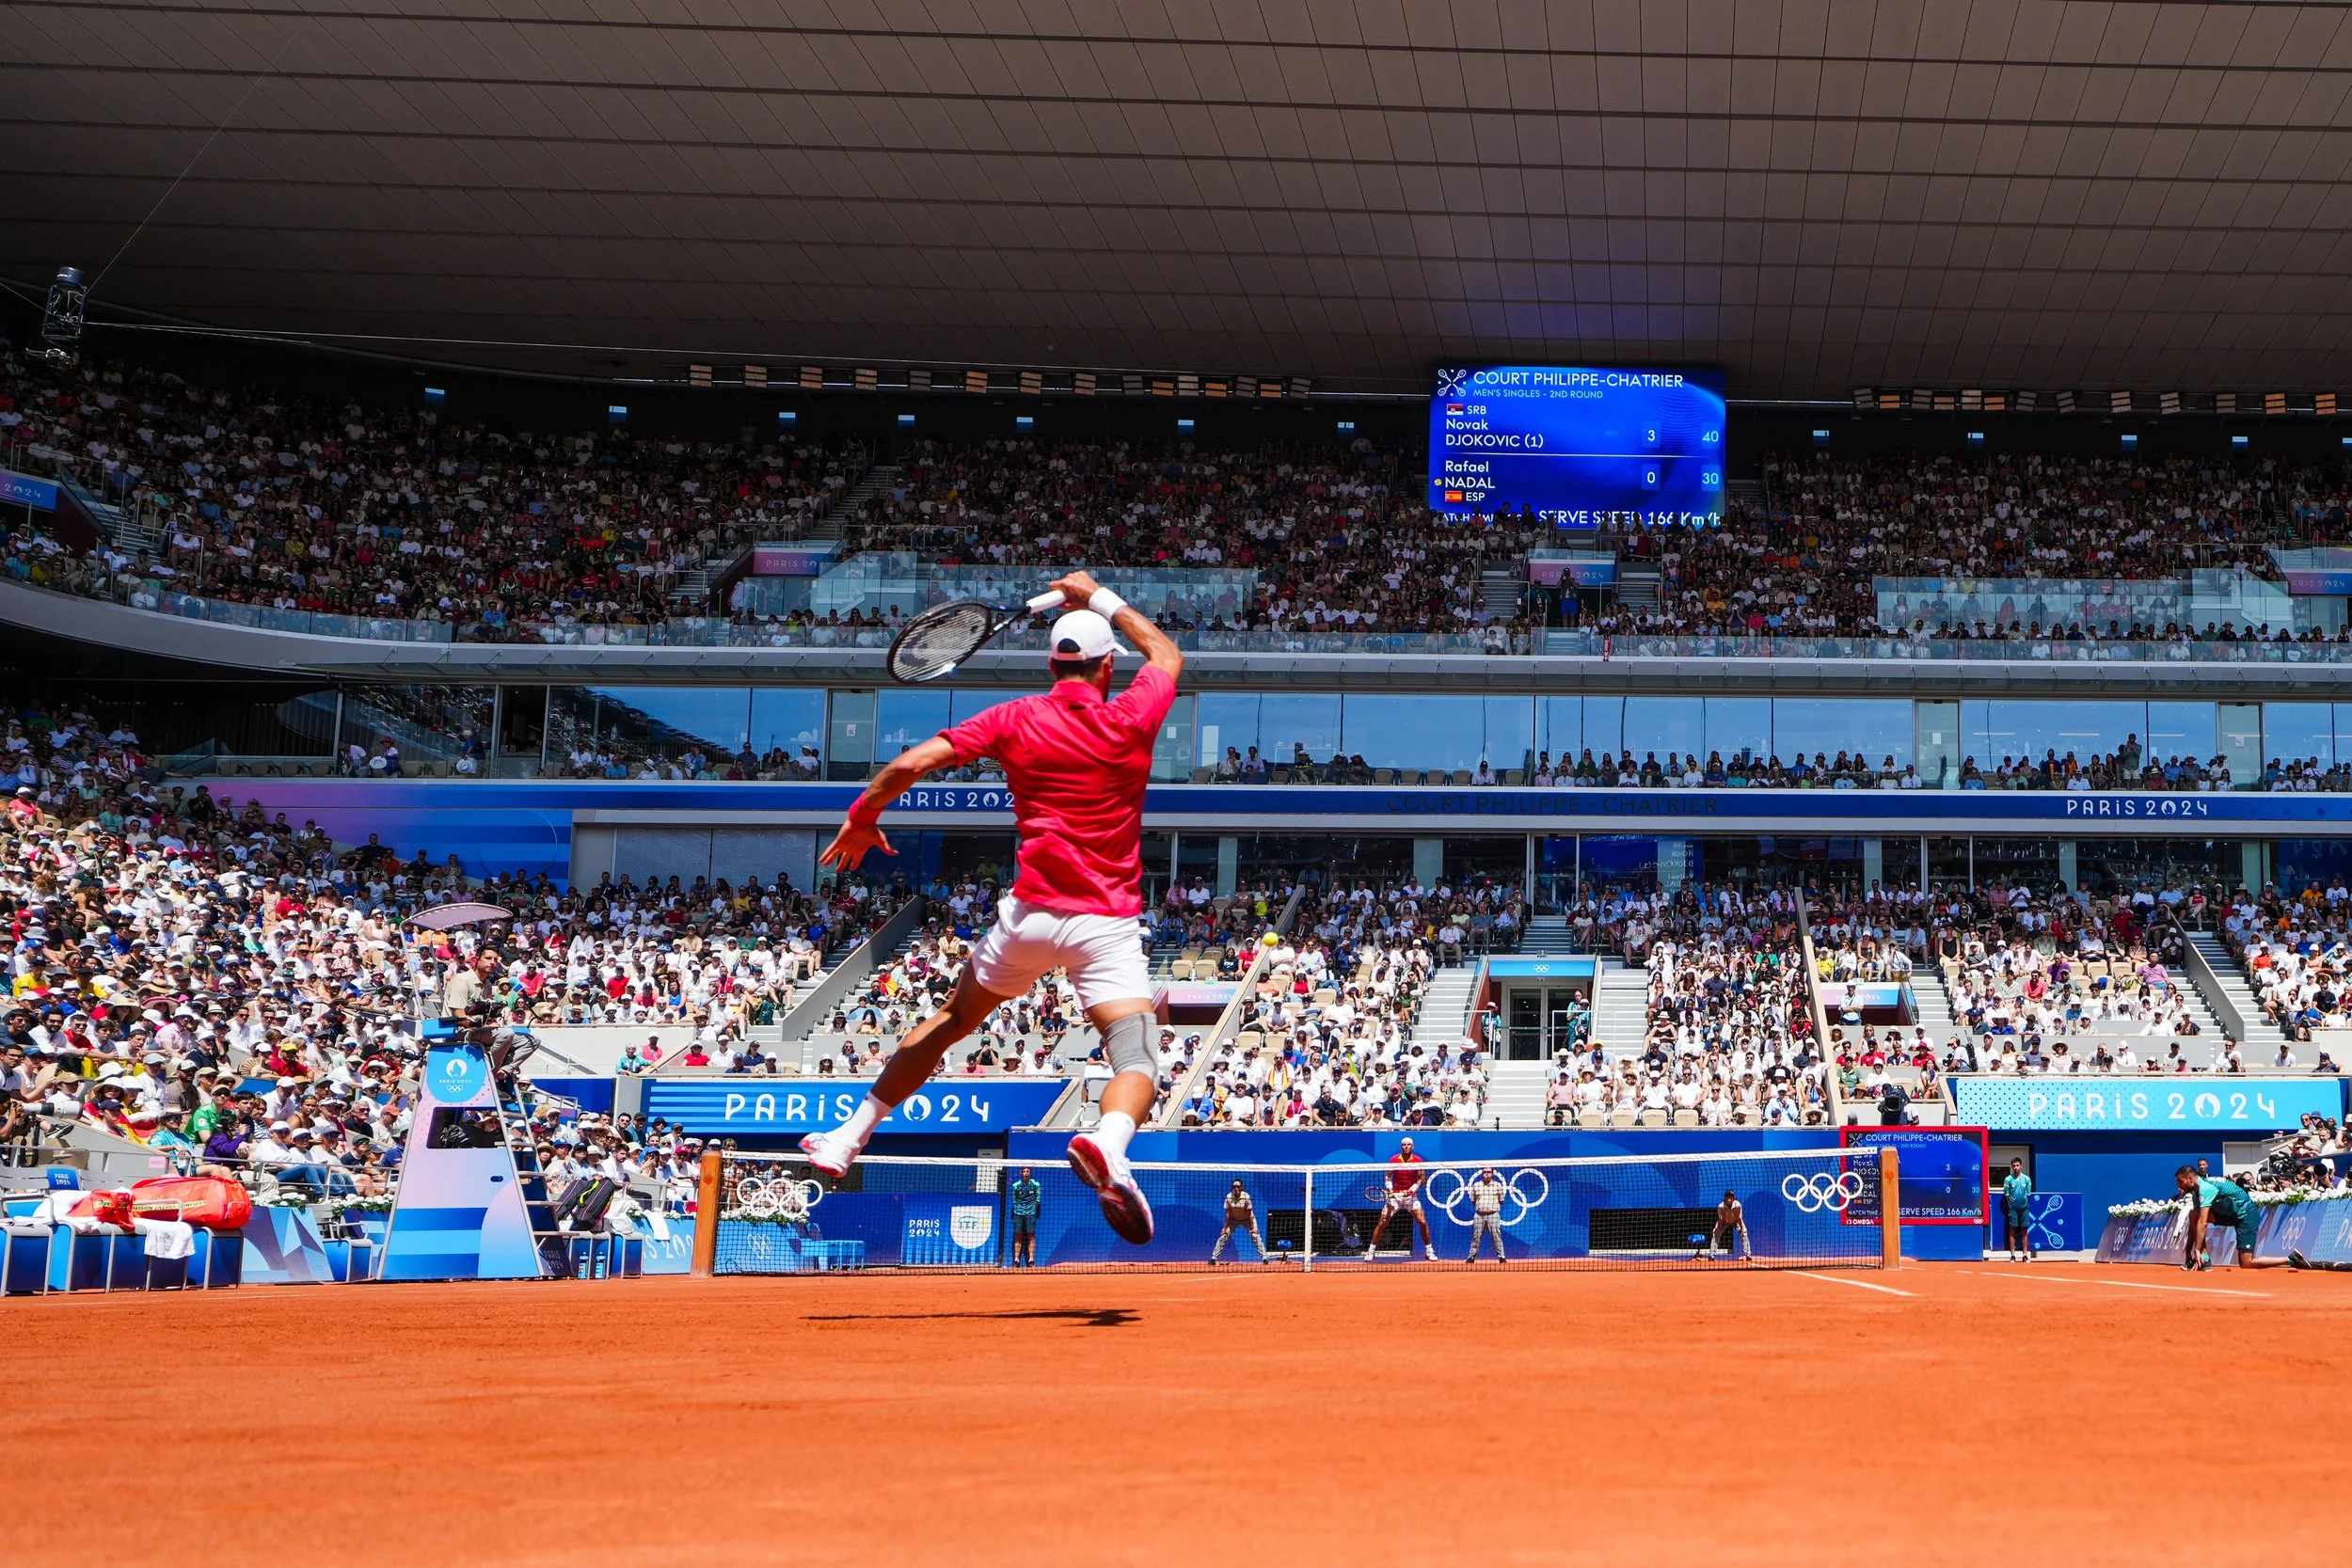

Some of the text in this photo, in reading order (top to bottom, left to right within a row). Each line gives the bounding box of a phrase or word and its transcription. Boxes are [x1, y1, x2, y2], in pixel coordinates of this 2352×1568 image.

[1473, 372, 1683, 388] COURT PHILIPPE-CHATRIER
[1503, 389, 1540, 398] SINGLES
[1549, 390, 1568, 399] 2ND
[1570, 390, 1603, 399] ROUND
[1467, 405, 1486, 415] SRB
[1446, 419, 1488, 431] Novak
[1446, 434, 1544, 449] DJOKOVIC (1)
[1647, 430, 1655, 441] 3
[1702, 431, 1719, 442] 40
[1446, 460, 1489, 472] Rafael
[1445, 477, 1495, 488] NADAL
[1647, 471, 1655, 483] 0
[1702, 472, 1719, 484] 30
[5, 483, 40, 499] 2024
[1466, 493, 1486, 501] ESP
[967, 792, 1015, 807] 202
[1387, 794, 1469, 813] COURT
[1476, 795, 1581, 813] PHILIPPE
[1602, 796, 1718, 815] CHATRIER
[2146, 800, 2208, 816] 2024
[880, 1094, 990, 1122] 024
[2167, 1092, 2275, 1119] 2024
[1866, 1133, 1963, 1142] COURT PHILIPPE-CHATRIER
[1962, 1208, 1981, 1216] Km/h
[909, 1228, 940, 1238] 2024
